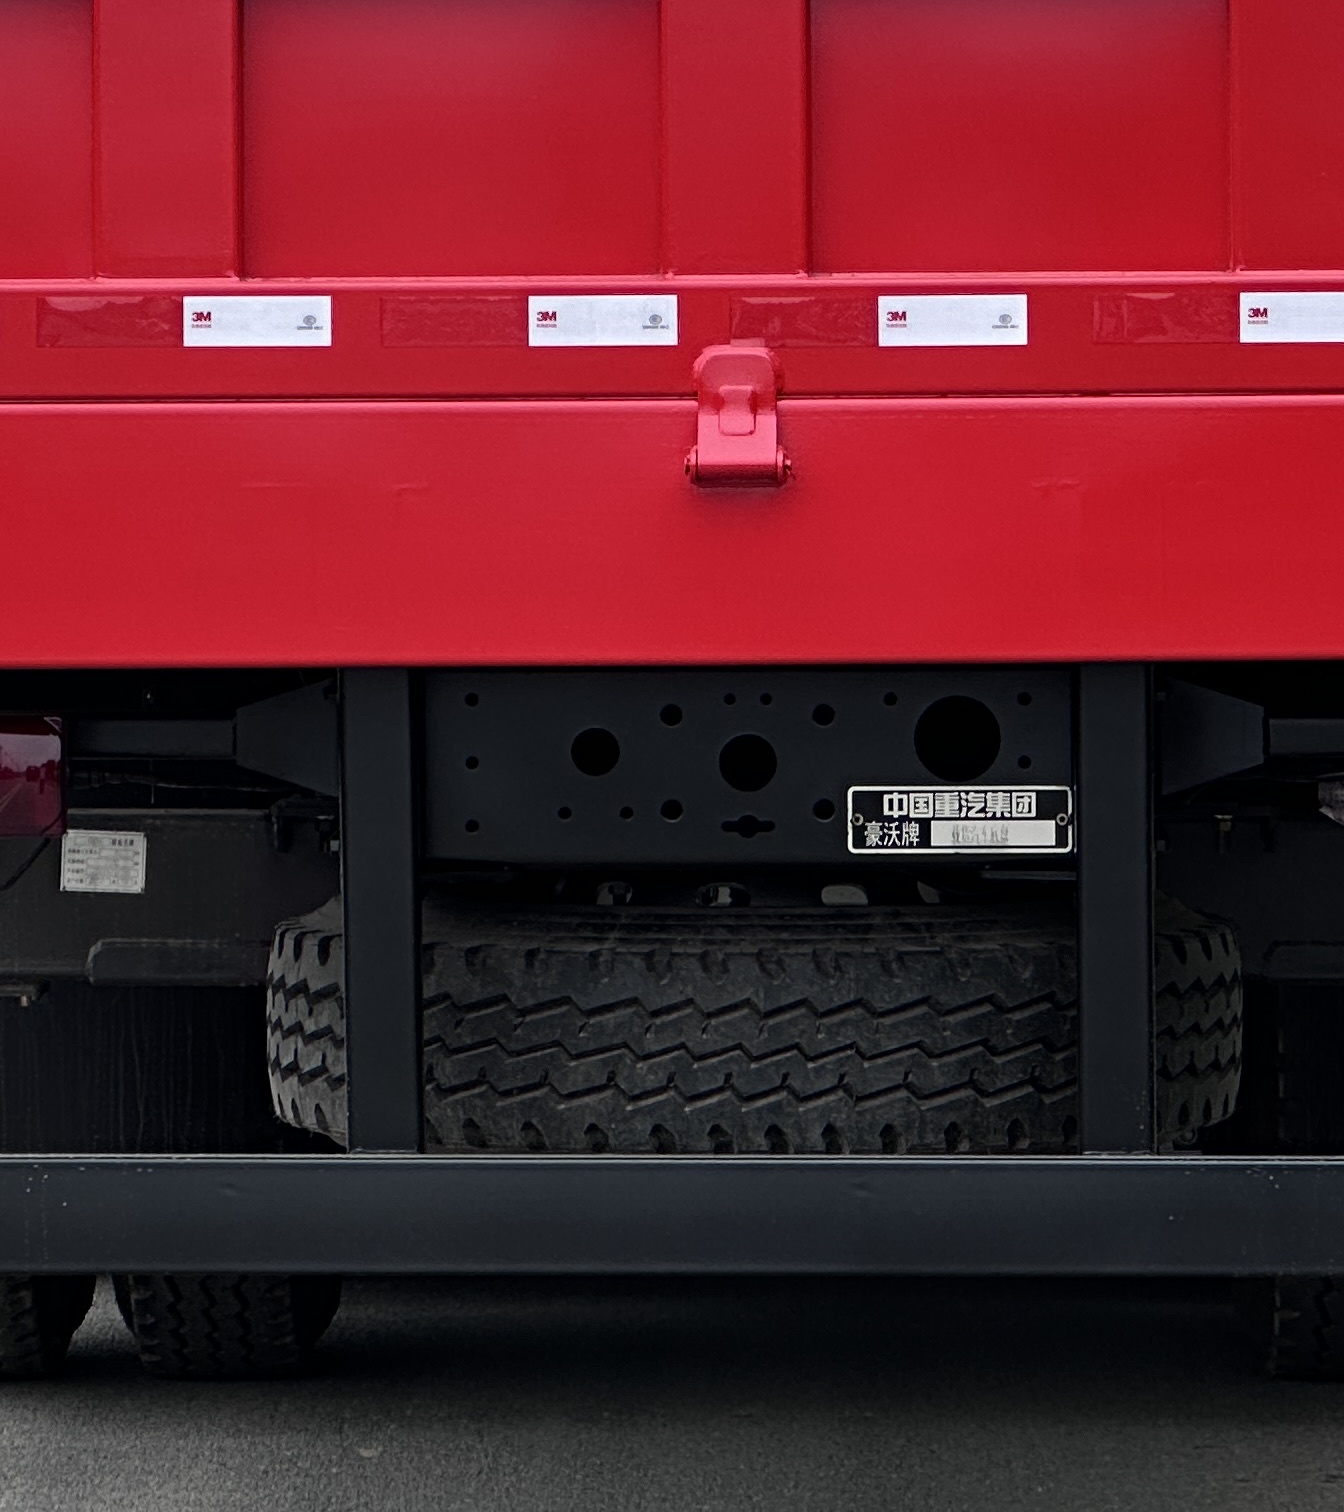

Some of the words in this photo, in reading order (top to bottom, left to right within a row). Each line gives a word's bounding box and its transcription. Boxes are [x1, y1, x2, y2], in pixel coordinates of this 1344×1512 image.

[189, 311, 212, 323] 3M
[535, 310, 557, 322] 3M
[884, 311, 907, 322] 3M
[1246, 307, 1268, 319] 3M
[883, 791, 1037, 818] 中国重汽集团
[864, 821, 920, 847] 豪沃牌
